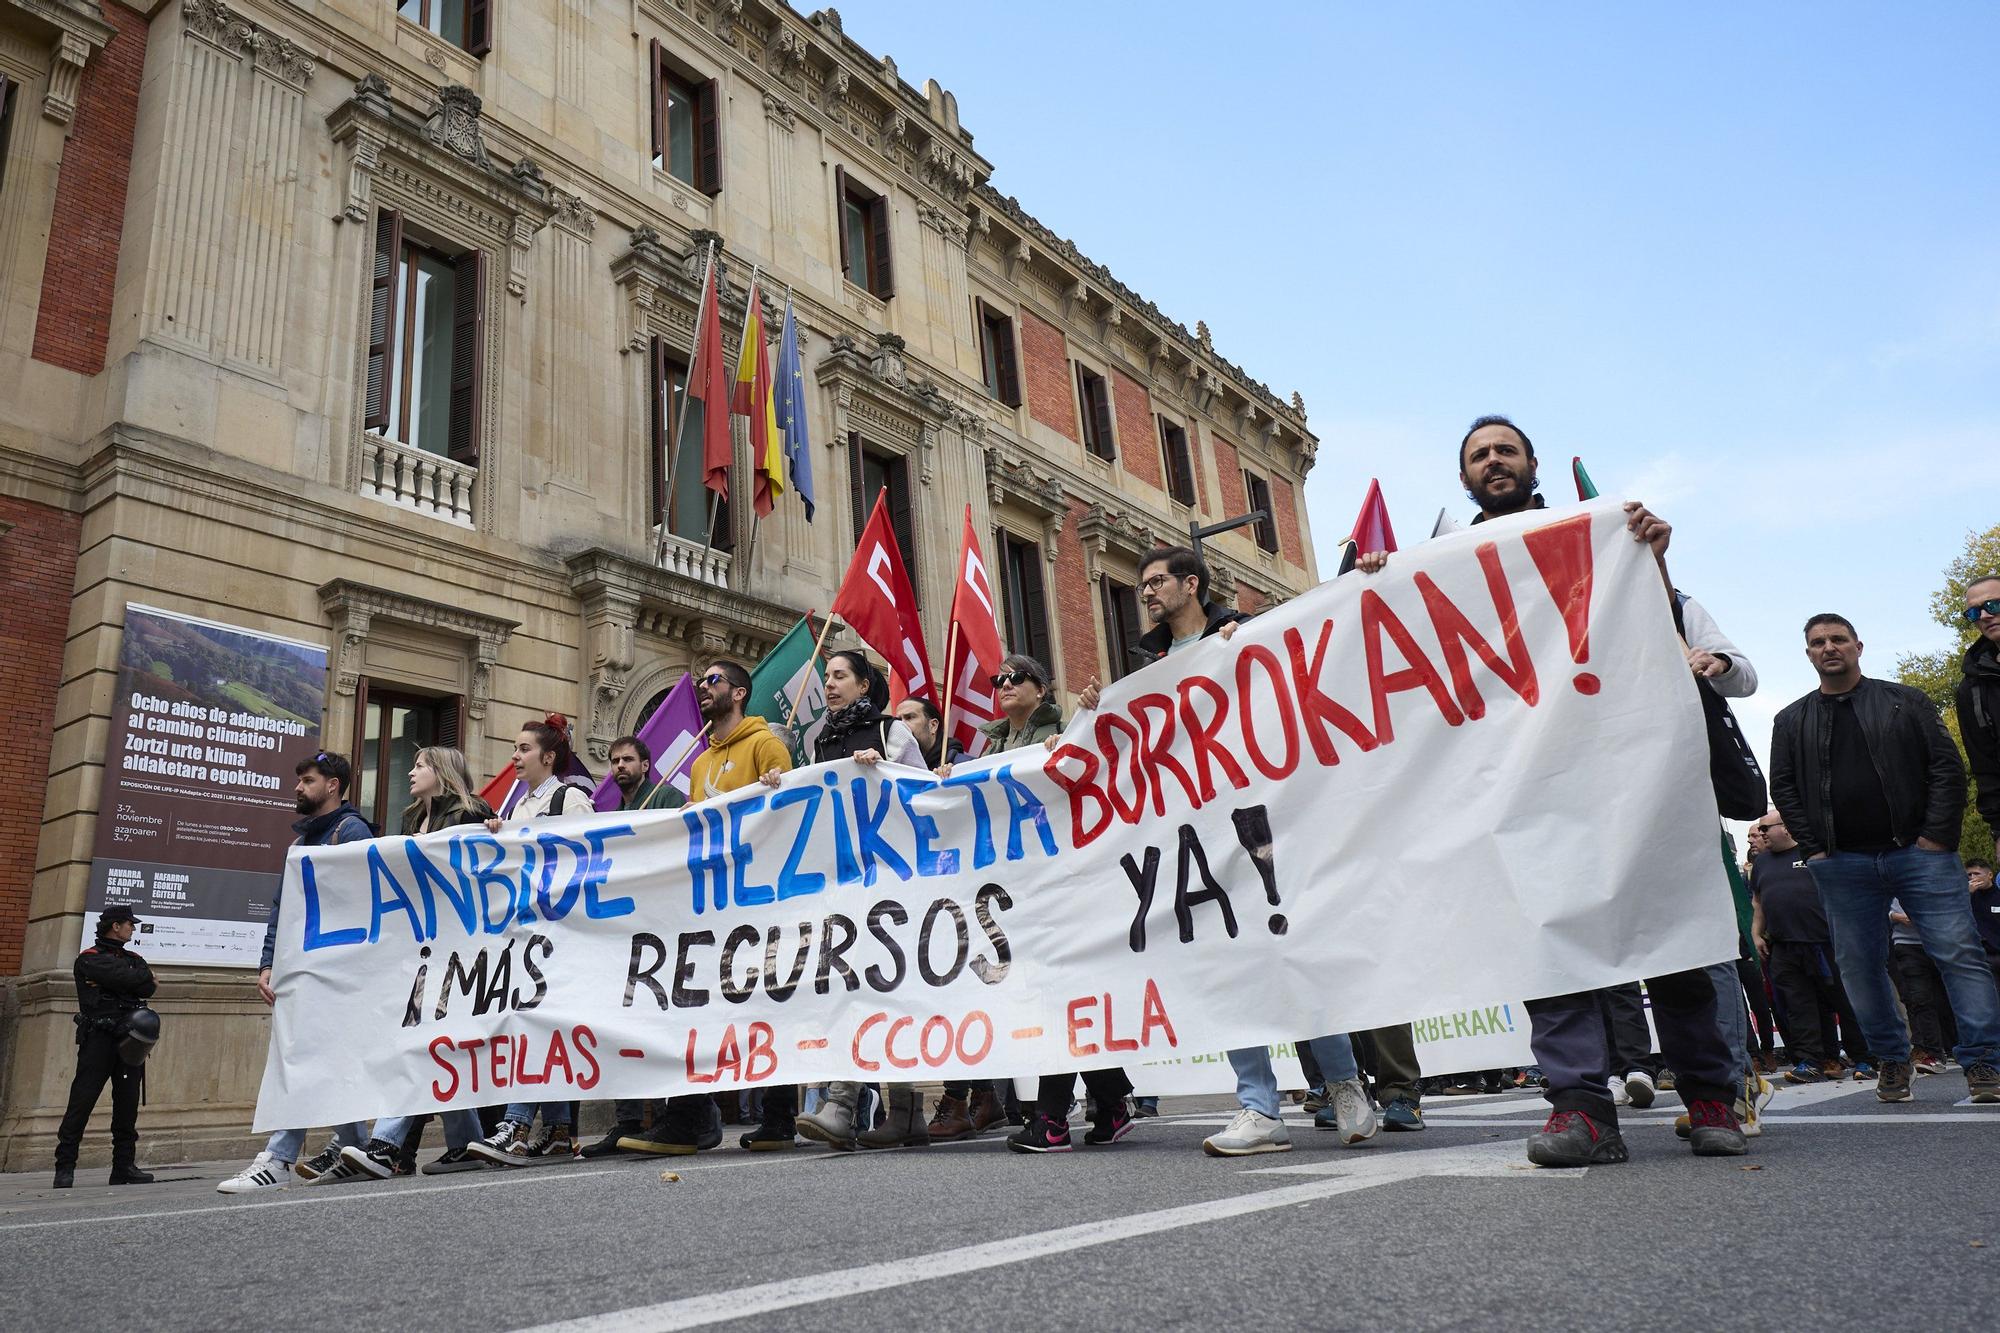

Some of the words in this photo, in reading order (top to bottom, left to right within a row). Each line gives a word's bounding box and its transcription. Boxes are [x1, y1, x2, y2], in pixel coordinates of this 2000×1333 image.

[1044, 513, 1602, 849] BORROKAN!
[131, 692, 169, 714] Ocho
[171, 700, 207, 721] años
[209, 707, 227, 724] de
[229, 712, 306, 737] adaptación
[773, 690, 801, 748] EUSAL
[128, 713, 143, 729] al
[147, 716, 204, 739] cambio
[207, 726, 275, 750] climático
[125, 733, 169, 756] Zortzi
[171, 742, 202, 761] urte
[205, 746, 247, 768] klima
[123, 754, 207, 781] aldaketara
[210, 768, 281, 790] egokitzen
[120, 780, 153, 791] EXPOSICIÓN
[116, 813, 163, 824] noviembre
[114, 826, 157, 837] azaroaren
[107, 877, 116, 886] SE
[117, 878, 145, 888] ADAPTA
[108, 868, 142, 879] NAVARRA
[154, 872, 189, 883] NAFARROA
[106, 886, 121, 895] POR
[122, 887, 130, 896] TI
[152, 889, 176, 899] EGITEN
[176, 890, 186, 900] DA
[153, 881, 183, 891] EGOKITU
[402, 934, 553, 1028] ¡MÁS
[622, 883, 1014, 1011] RECURSOS
[1120, 803, 1289, 953] YA!
[1412, 1004, 1515, 1044] RBERAK!
[428, 1025, 601, 1103] STEILAS
[684, 1021, 779, 1083] LAB
[851, 1010, 994, 1071] CCOO
[1066, 977, 1179, 1058] ELA
